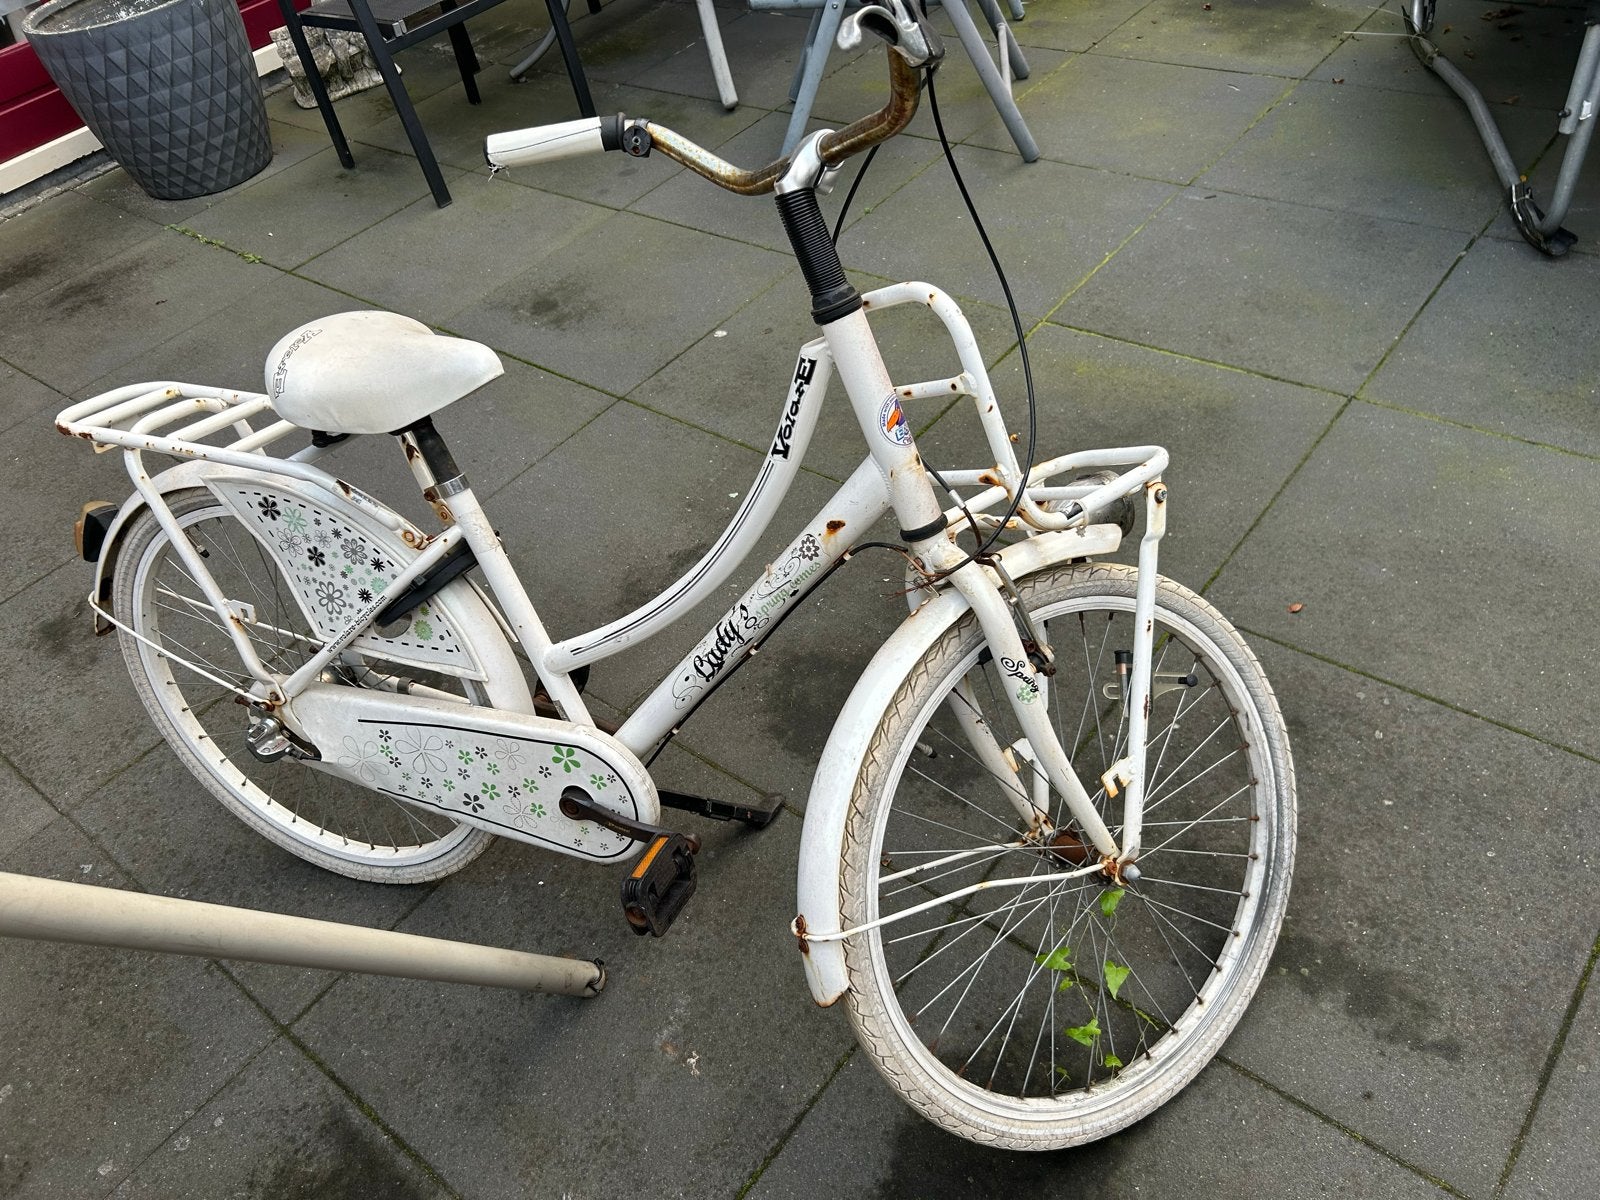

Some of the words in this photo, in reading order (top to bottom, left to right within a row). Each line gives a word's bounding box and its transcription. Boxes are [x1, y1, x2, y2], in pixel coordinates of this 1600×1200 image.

[755, 589, 790, 618] spring
[790, 561, 822, 590] comes
[694, 603, 749, 682] Lady's
[1000, 656, 1039, 693] Spring
